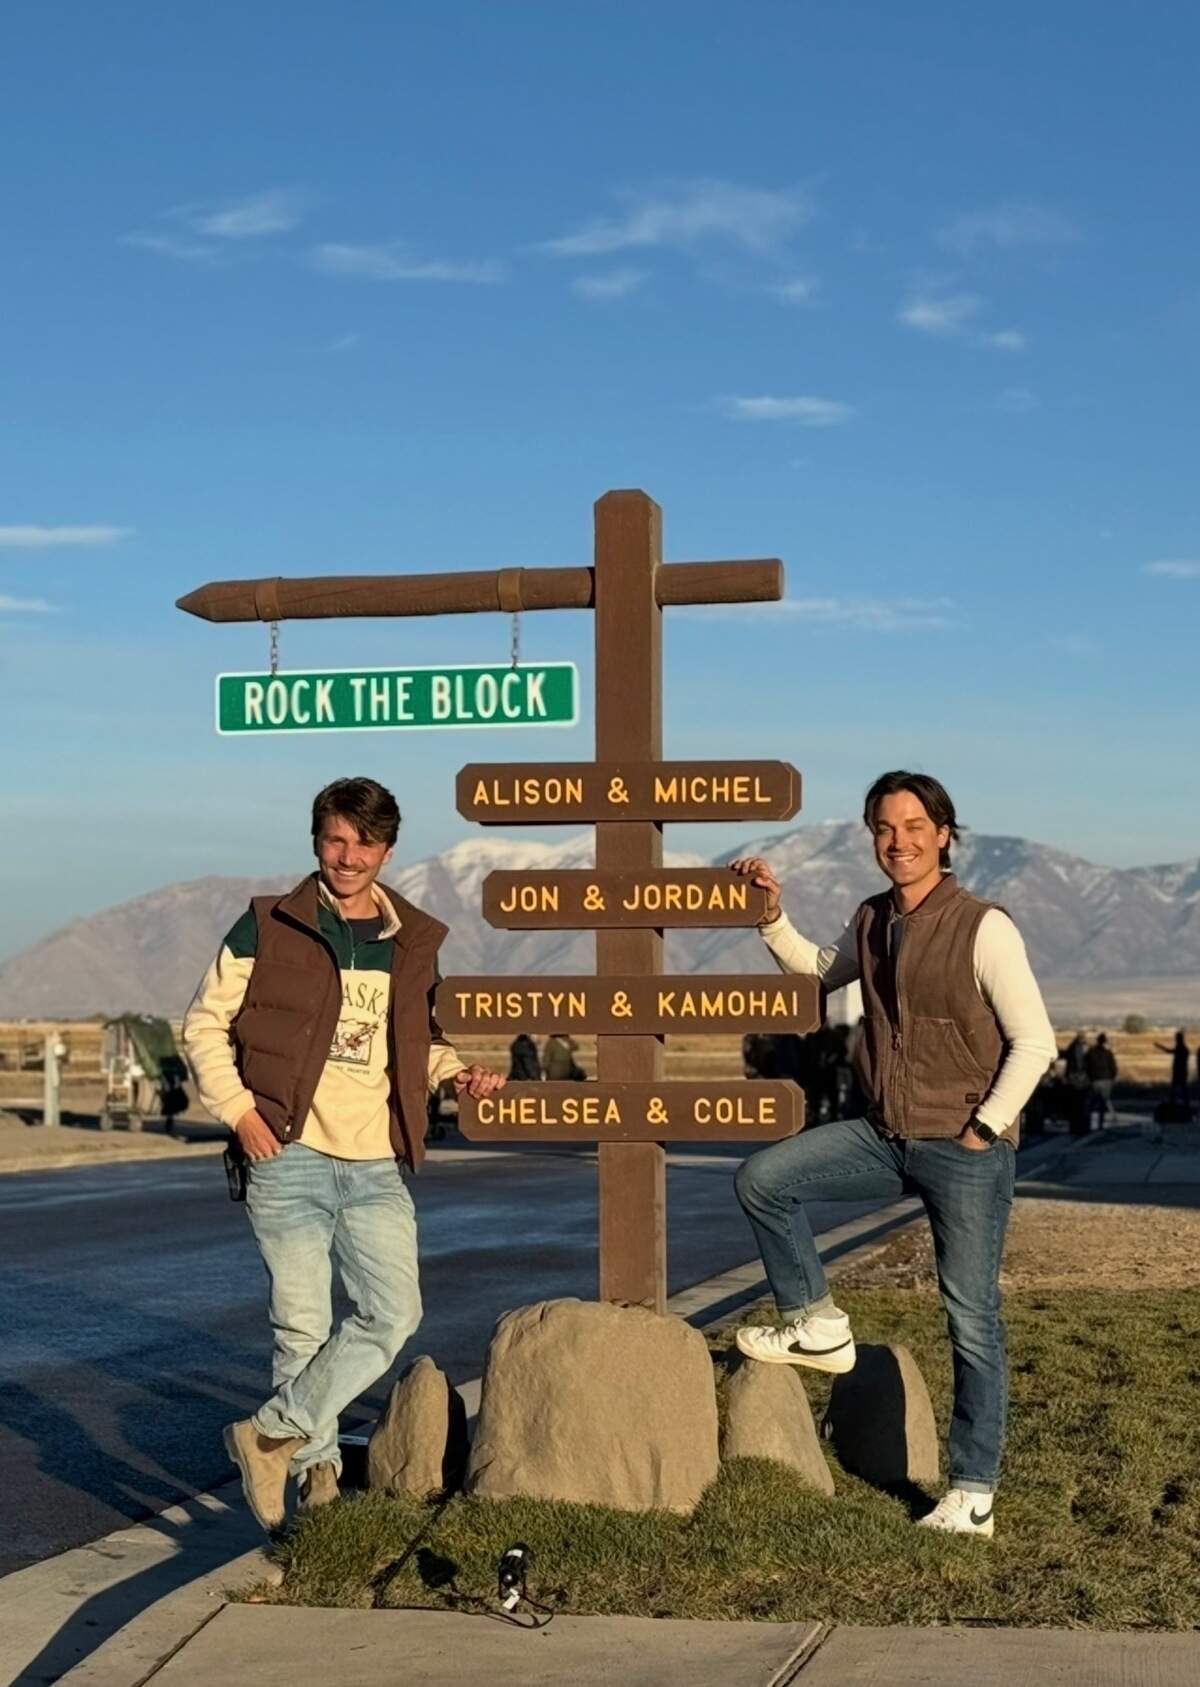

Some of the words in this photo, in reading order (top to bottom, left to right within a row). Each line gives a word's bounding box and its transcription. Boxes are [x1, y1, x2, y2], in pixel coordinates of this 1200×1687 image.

[245, 679, 335, 725] ROCK
[350, 676, 414, 722] THE
[431, 671, 547, 719] BLOCK
[473, 778, 583, 805] ALISON
[607, 777, 629, 803] &
[655, 776, 771, 803] MICHEL
[500, 886, 559, 912] JON
[583, 885, 605, 911] &
[623, 884, 747, 911] JORDAN
[456, 992, 587, 1018] TRISTYN
[611, 991, 633, 1017] &
[658, 990, 798, 1017] KAMOHAI
[478, 1098, 621, 1125] CHELSEA
[646, 1098, 669, 1124] &
[694, 1098, 776, 1125] COLE
